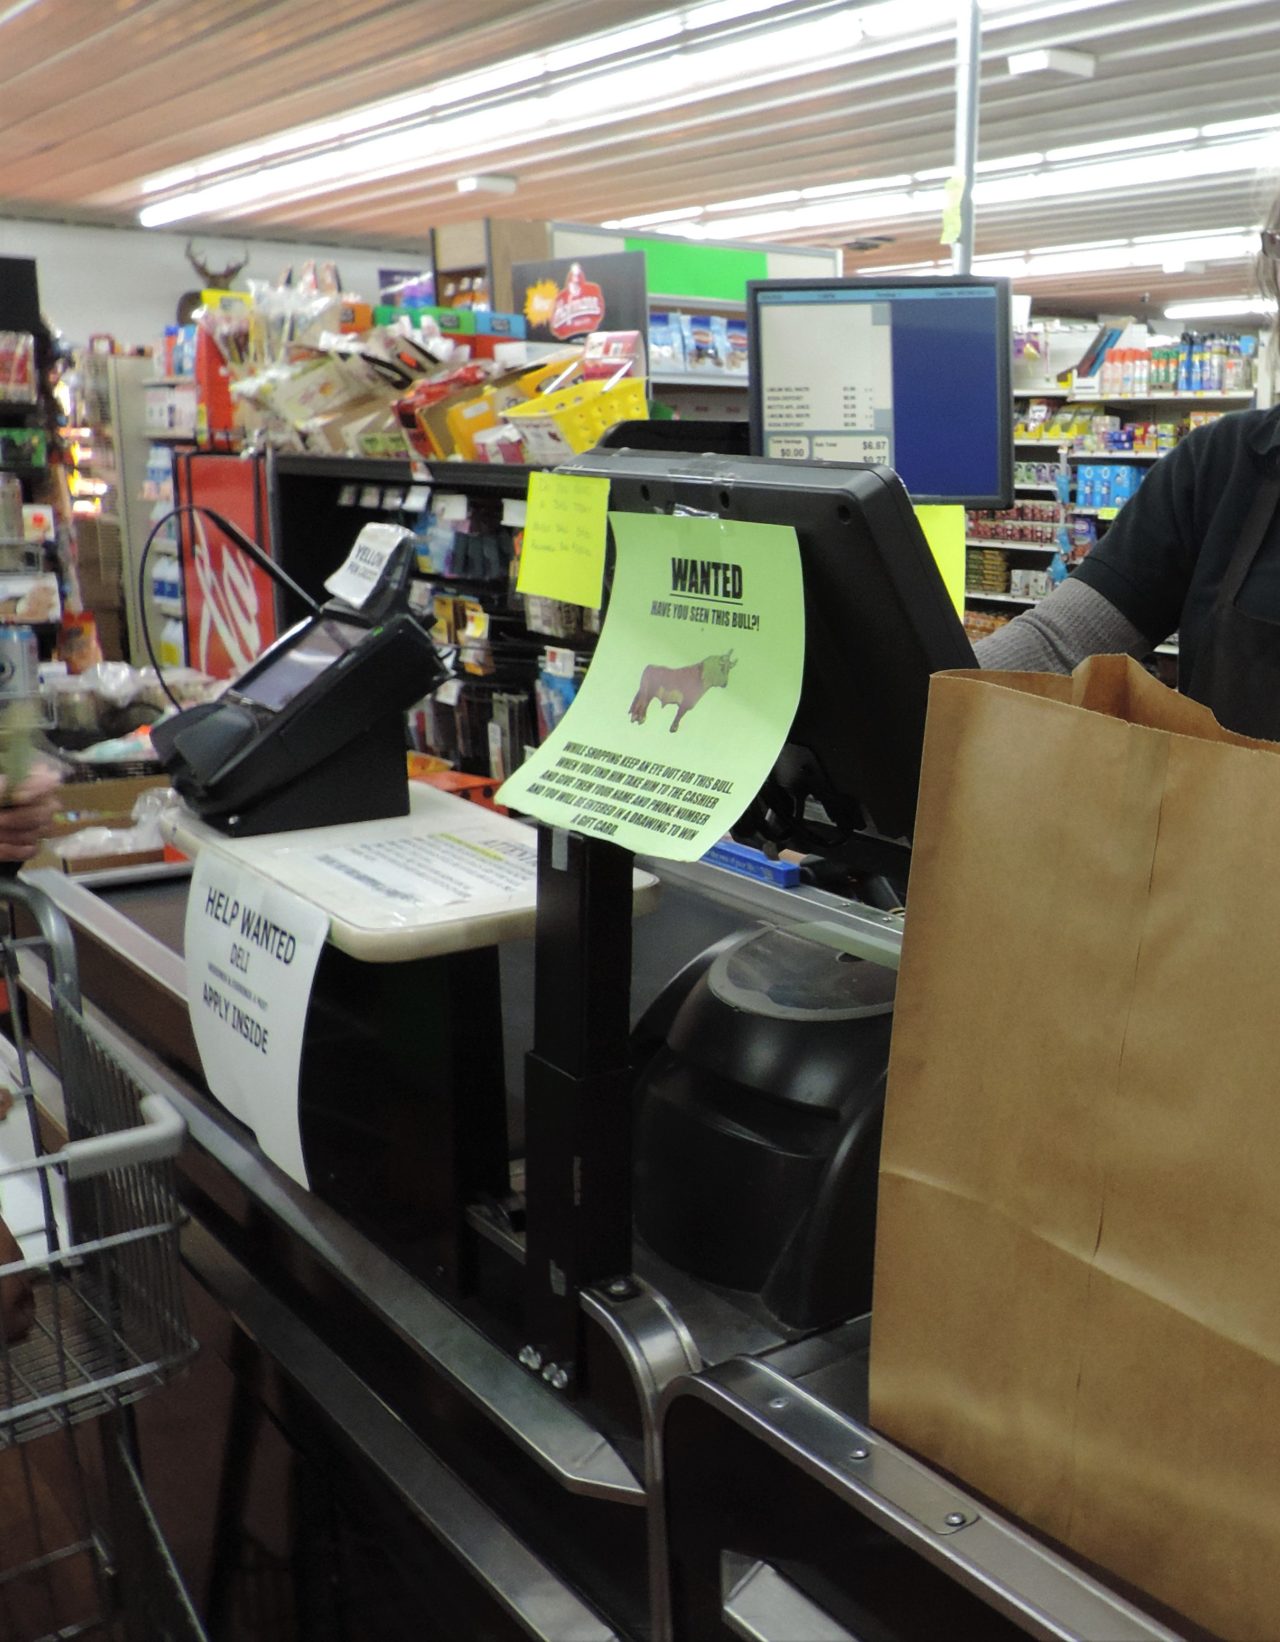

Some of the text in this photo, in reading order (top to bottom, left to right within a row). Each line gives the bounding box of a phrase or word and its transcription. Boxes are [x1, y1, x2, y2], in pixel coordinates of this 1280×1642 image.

[781, 448, 805, 457] $0.00
[355, 544, 385, 568] YELLOW
[671, 557, 743, 599] WANTED
[651, 600, 760, 631] HAVE YOU SEEN THIS BULL?!
[555, 756, 720, 809] WHEN YOU FIND HIM TAKE HIM TO THE CASHIER
[563, 741, 588, 756] WHILE
[584, 747, 622, 765] SHOPPING
[619, 755, 641, 769] KEEP
[637, 760, 652, 772] AN
[648, 763, 666, 776] EYE
[661, 767, 681, 780] OUT
[677, 770, 696, 784] FOR
[693, 774, 715, 789] THIS
[526, 783, 700, 841] AND YOU WILL BE ENTERED IN A DRAWING TO WIN
[539, 770, 711, 826] AND GIVE THEM YOUR NAME AND PHONE NUMBER
[570, 813, 582, 824] A
[577, 815, 598, 828] GIFT
[205, 886, 297, 965] HELP WANTED
[230, 943, 250, 974] DELI
[203, 983, 230, 1023] APPLY
[232, 1004, 269, 1054] INSIDE
